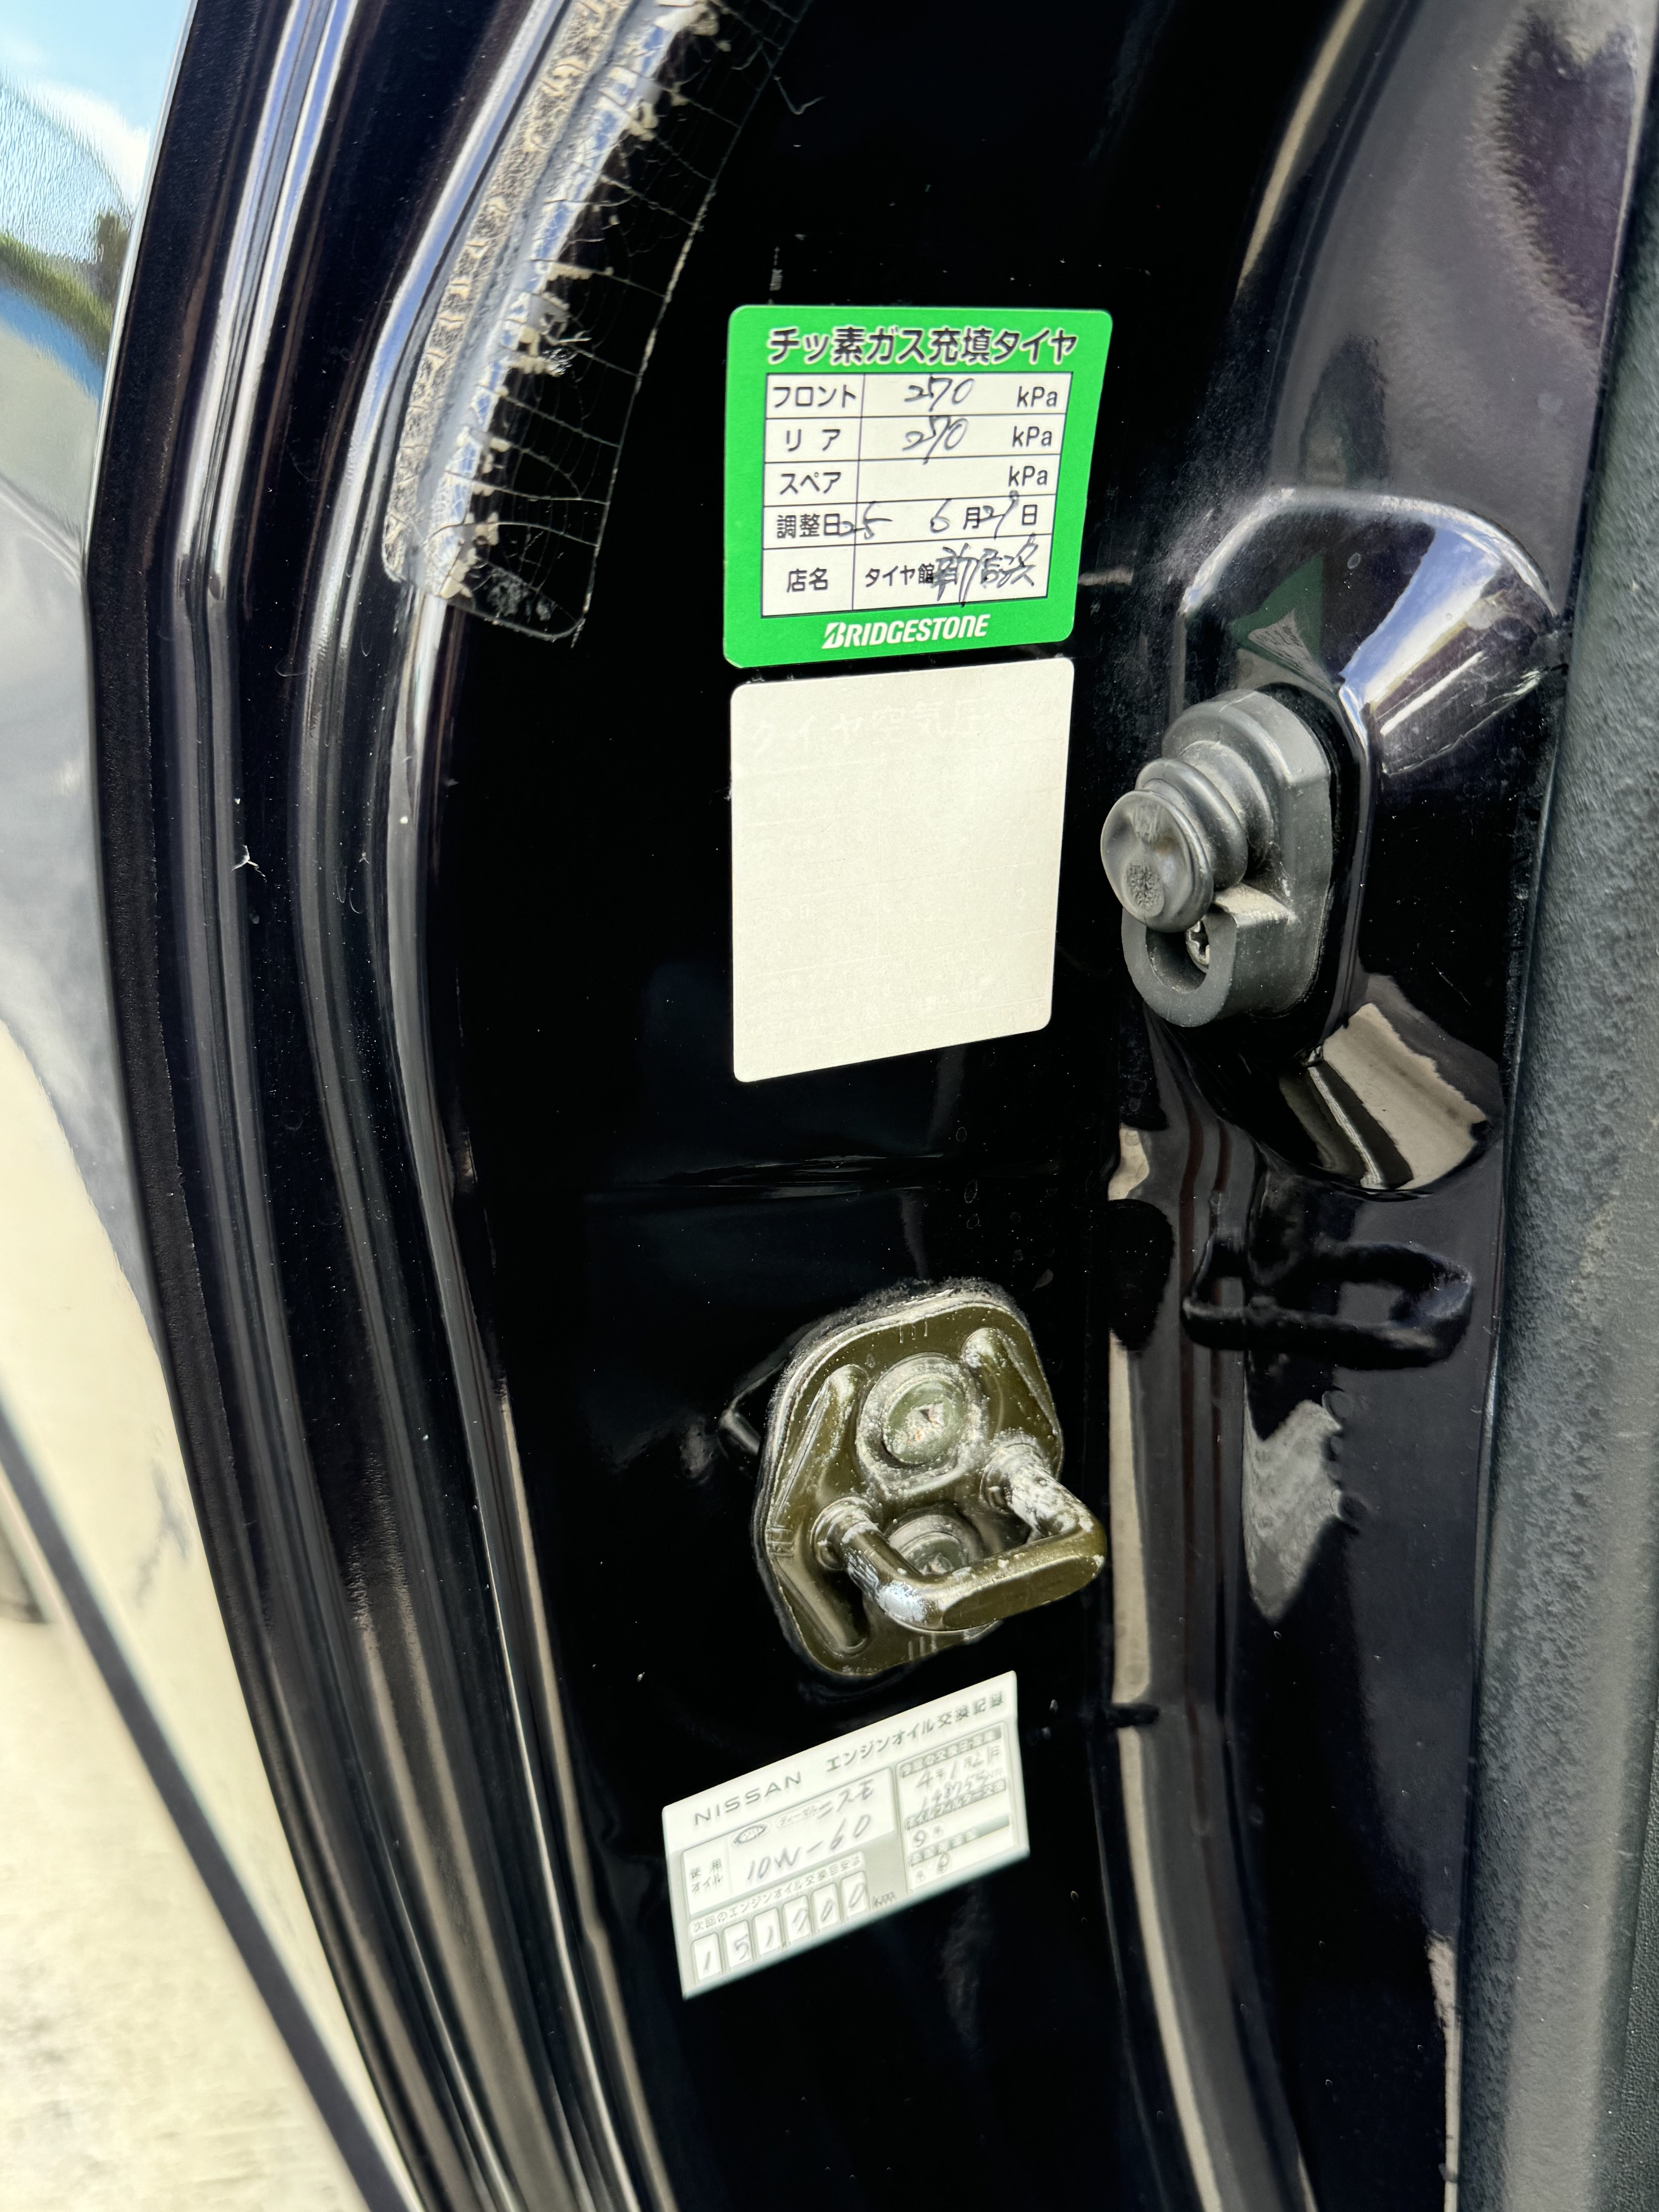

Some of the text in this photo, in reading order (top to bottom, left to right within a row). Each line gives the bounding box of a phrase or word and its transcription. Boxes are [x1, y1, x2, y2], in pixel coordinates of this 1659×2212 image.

[768, 326, 1077, 365] チッ素ガス充填タイヤ
[774, 385, 856, 408] フロント
[904, 375, 975, 412] 270
[1017, 386, 1058, 408] kPa
[902, 416, 969, 465] 270
[1012, 426, 1053, 448] kPa
[780, 471, 841, 495] スペア
[1008, 465, 1048, 487] kPa
[776, 513, 841, 539] 調整日
[787, 567, 829, 592] 店名
[821, 614, 991, 649] BRIDGESTONE
[827, 1691, 1004, 1772] エンジンオイル交換記録
[694, 1771, 802, 1826] NISSAN
[691, 1874, 723, 1893] オイル
